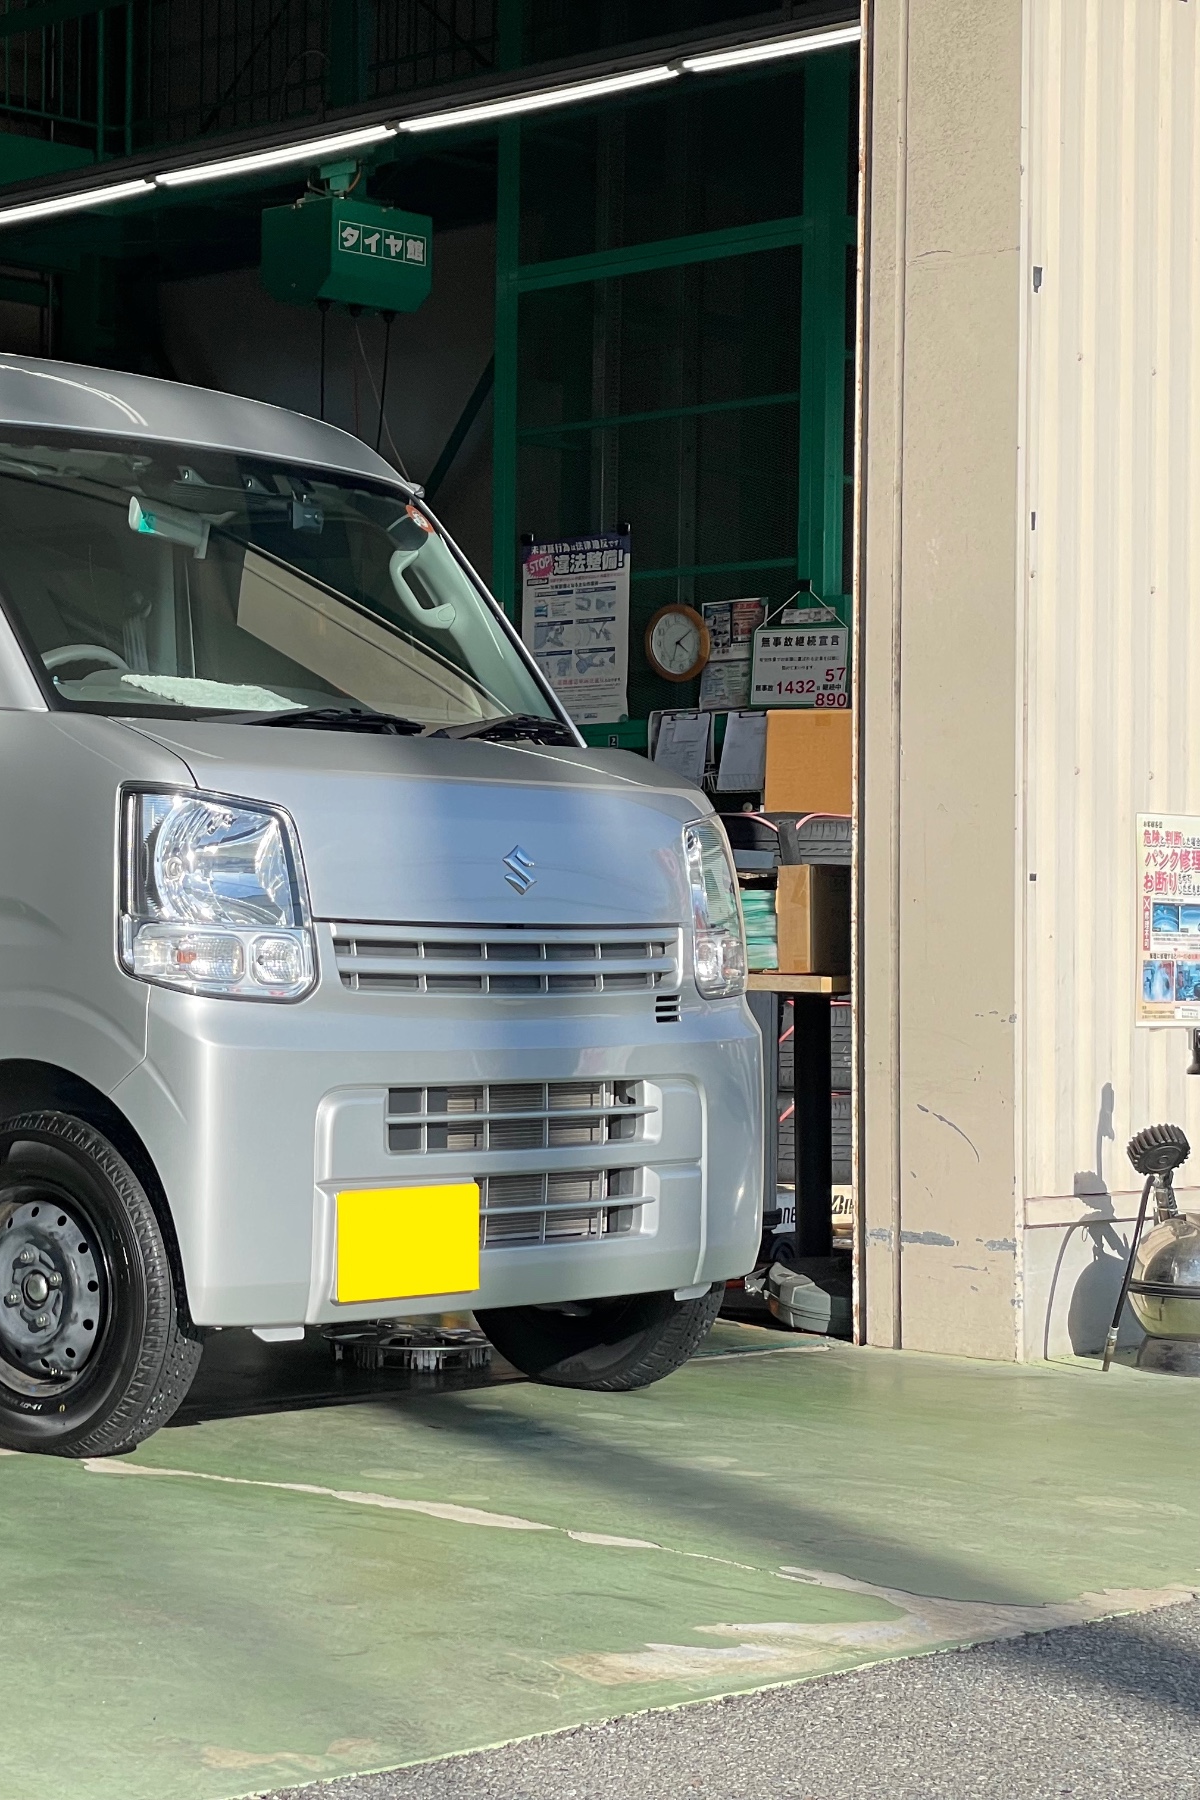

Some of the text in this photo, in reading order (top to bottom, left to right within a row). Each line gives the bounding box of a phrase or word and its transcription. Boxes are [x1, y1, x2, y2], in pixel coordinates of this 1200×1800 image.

[341, 226, 424, 262] タイヤ館
[761, 635, 840, 648] 無事故継続宣言
[825, 667, 846, 682] 57
[776, 680, 815, 694] 1432
[815, 692, 847, 707] 890
